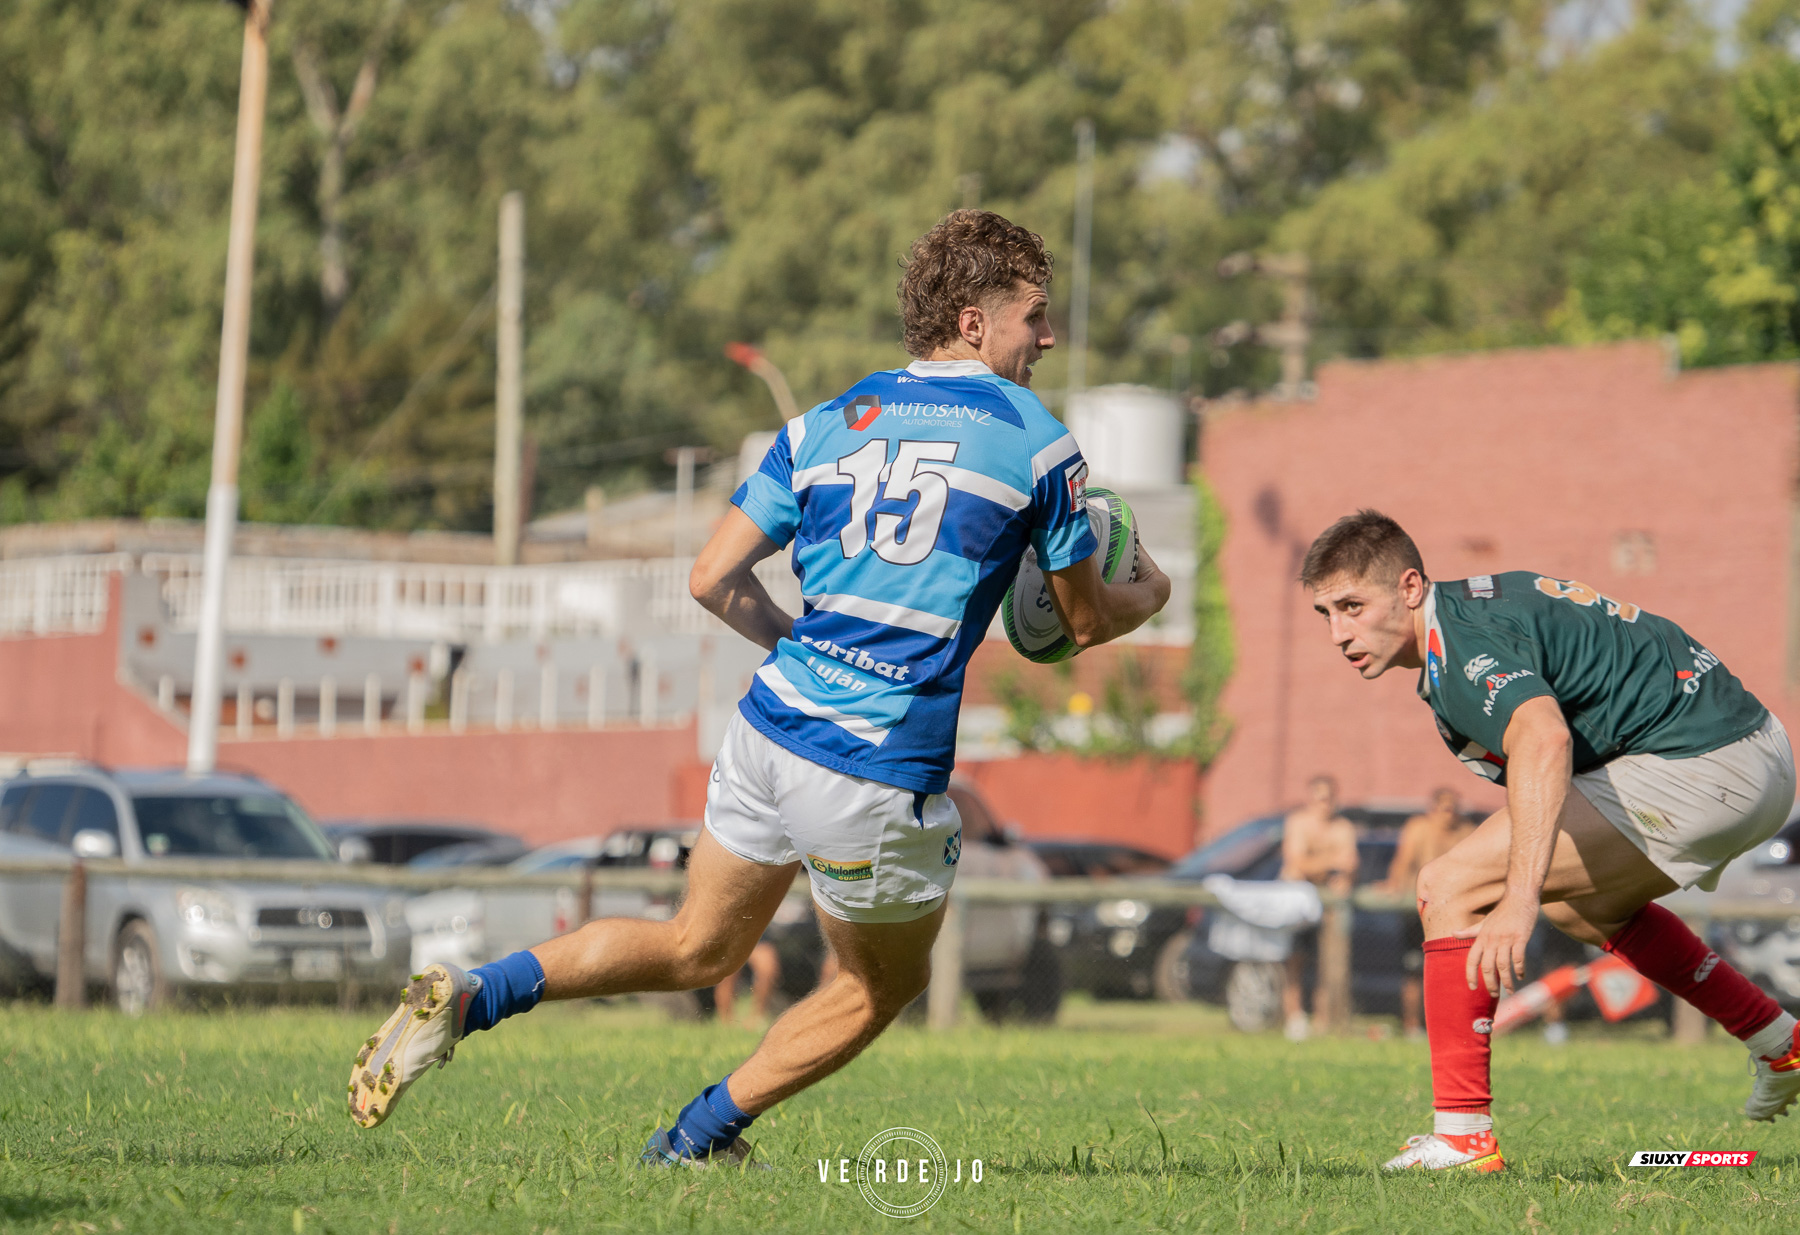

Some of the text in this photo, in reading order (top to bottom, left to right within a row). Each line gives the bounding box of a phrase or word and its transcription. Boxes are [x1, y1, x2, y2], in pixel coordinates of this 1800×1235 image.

[884, 402, 993, 426] AUTOSANZ
[902, 418, 963, 428] AUTOMOTORES
[837, 438, 960, 566] 15
[806, 656, 867, 692] Luján
[1483, 669, 1535, 717] MAGMA
